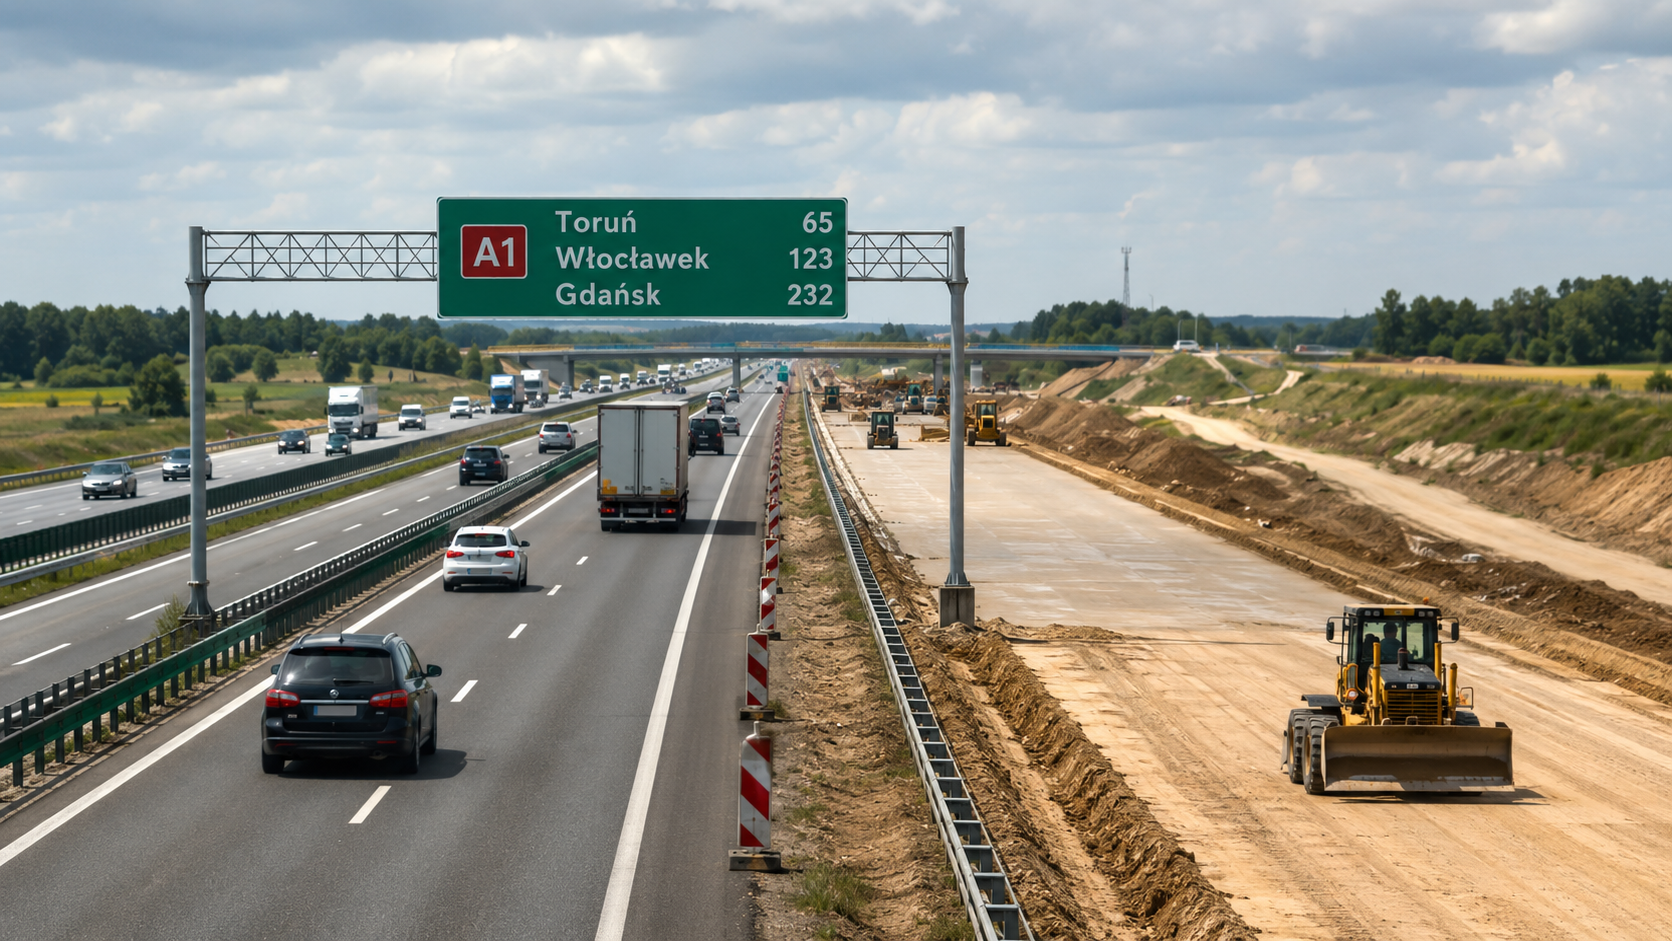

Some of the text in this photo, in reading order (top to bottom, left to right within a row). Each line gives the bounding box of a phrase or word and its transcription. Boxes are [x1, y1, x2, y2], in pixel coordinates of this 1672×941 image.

[556, 211, 832, 233] Toruń 65
[473, 237, 515, 267] A1
[556, 247, 832, 269] Włocławek 123
[556, 283, 832, 305] Gdańsk 232
